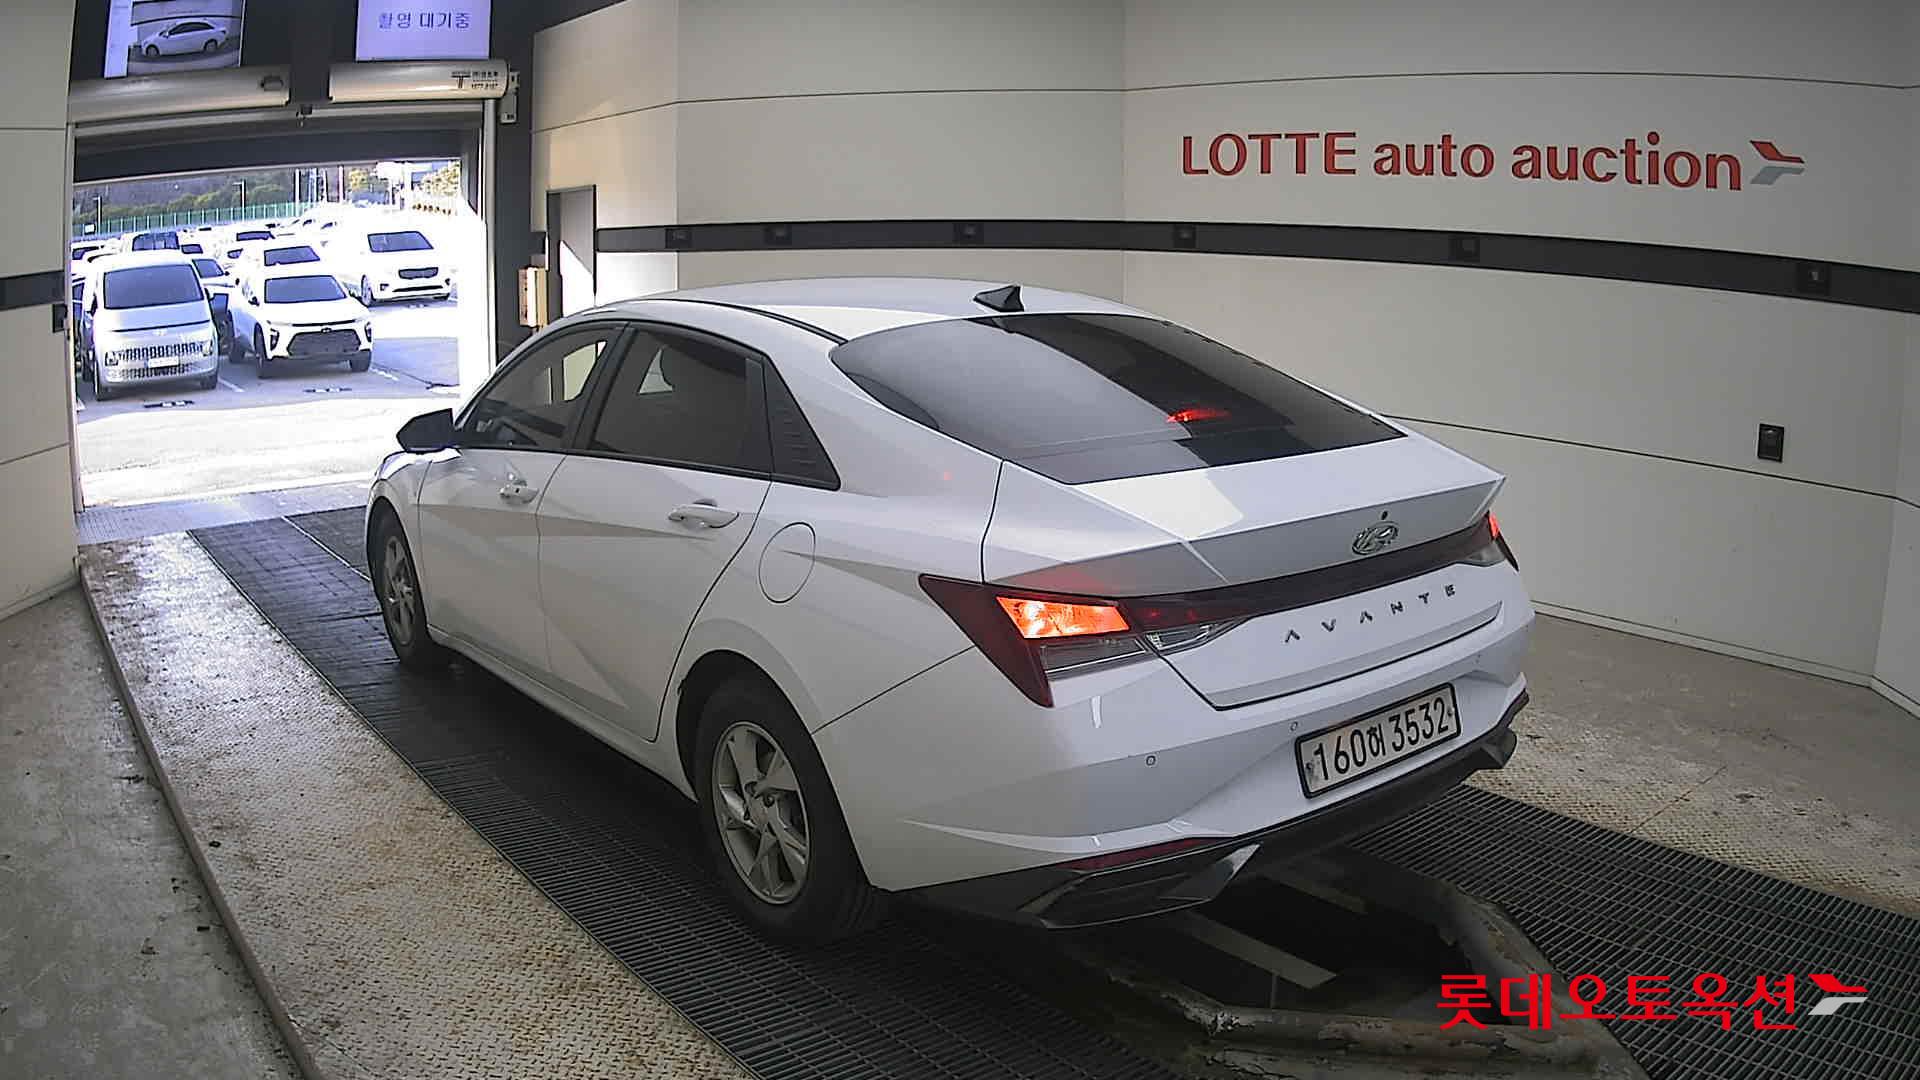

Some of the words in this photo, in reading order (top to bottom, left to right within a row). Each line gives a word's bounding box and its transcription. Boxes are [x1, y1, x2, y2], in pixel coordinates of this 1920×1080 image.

[419, 12, 470, 29] 대기중
[1182, 131, 1358, 176] LOTTE
[1373, 134, 1495, 178] auto
[1511, 131, 1742, 190] auction
[1284, 584, 1456, 644] AVANTE
